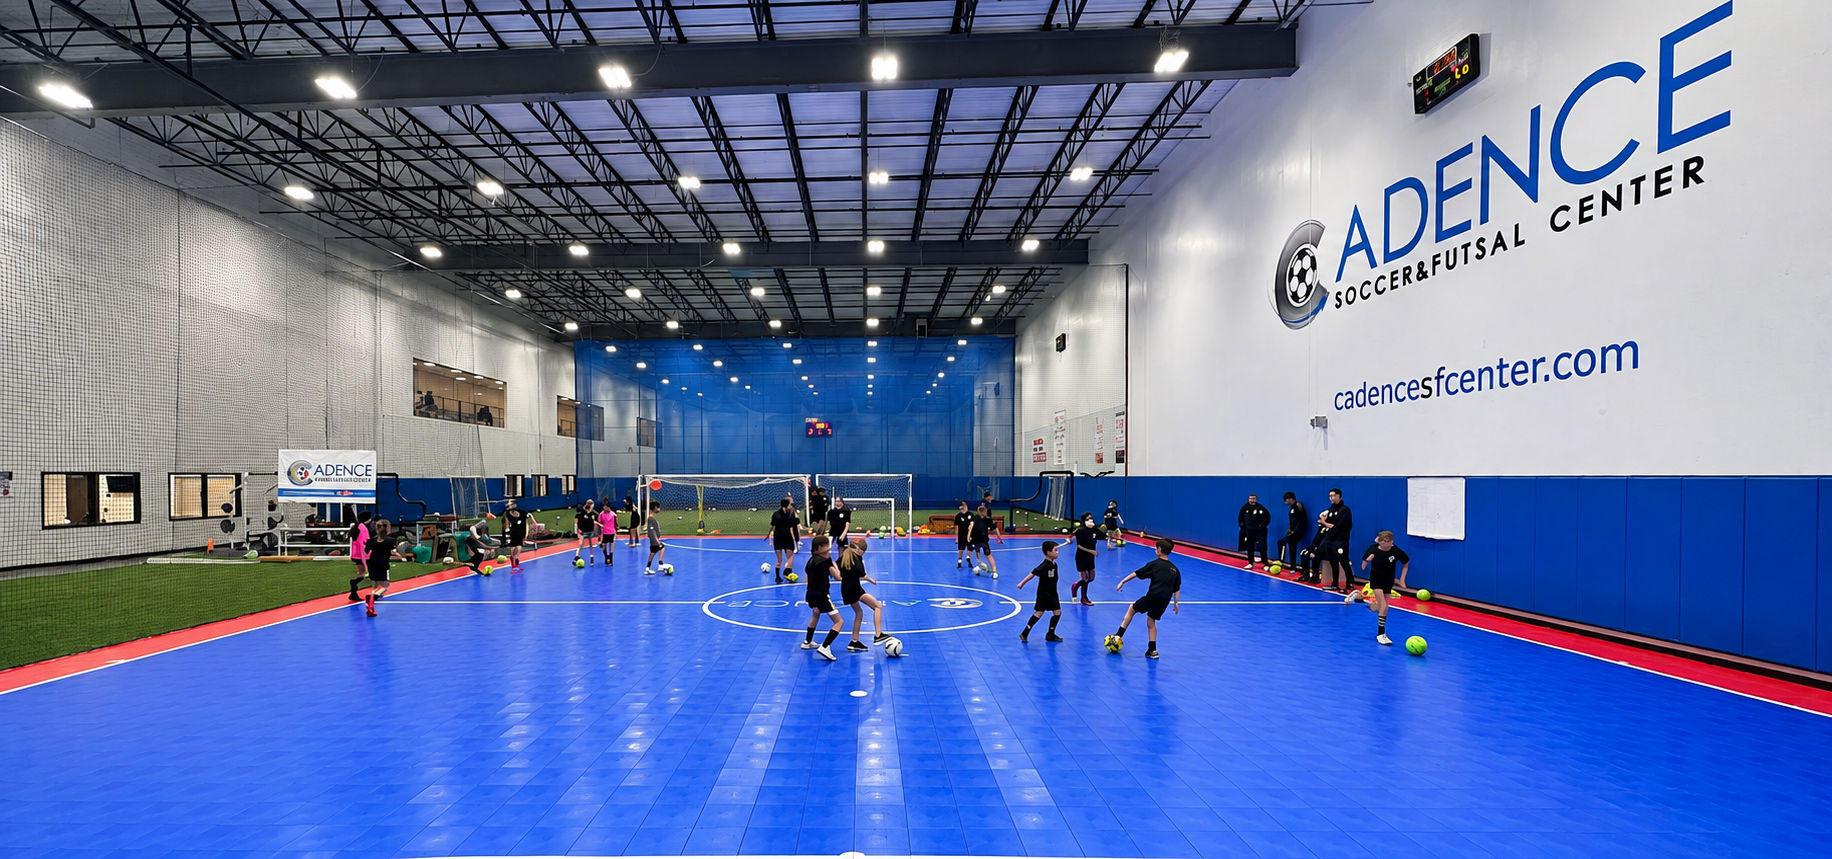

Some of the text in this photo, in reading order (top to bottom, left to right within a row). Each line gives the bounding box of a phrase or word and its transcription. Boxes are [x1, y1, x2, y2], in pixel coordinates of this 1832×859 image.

[1271, 0, 1733, 330] CADENCE
[1334, 155, 1705, 309] SOCCER&FUTSAL CENTER
[1334, 340, 1639, 411] cadencesfcenter.com
[287, 460, 373, 486] CADENCE
